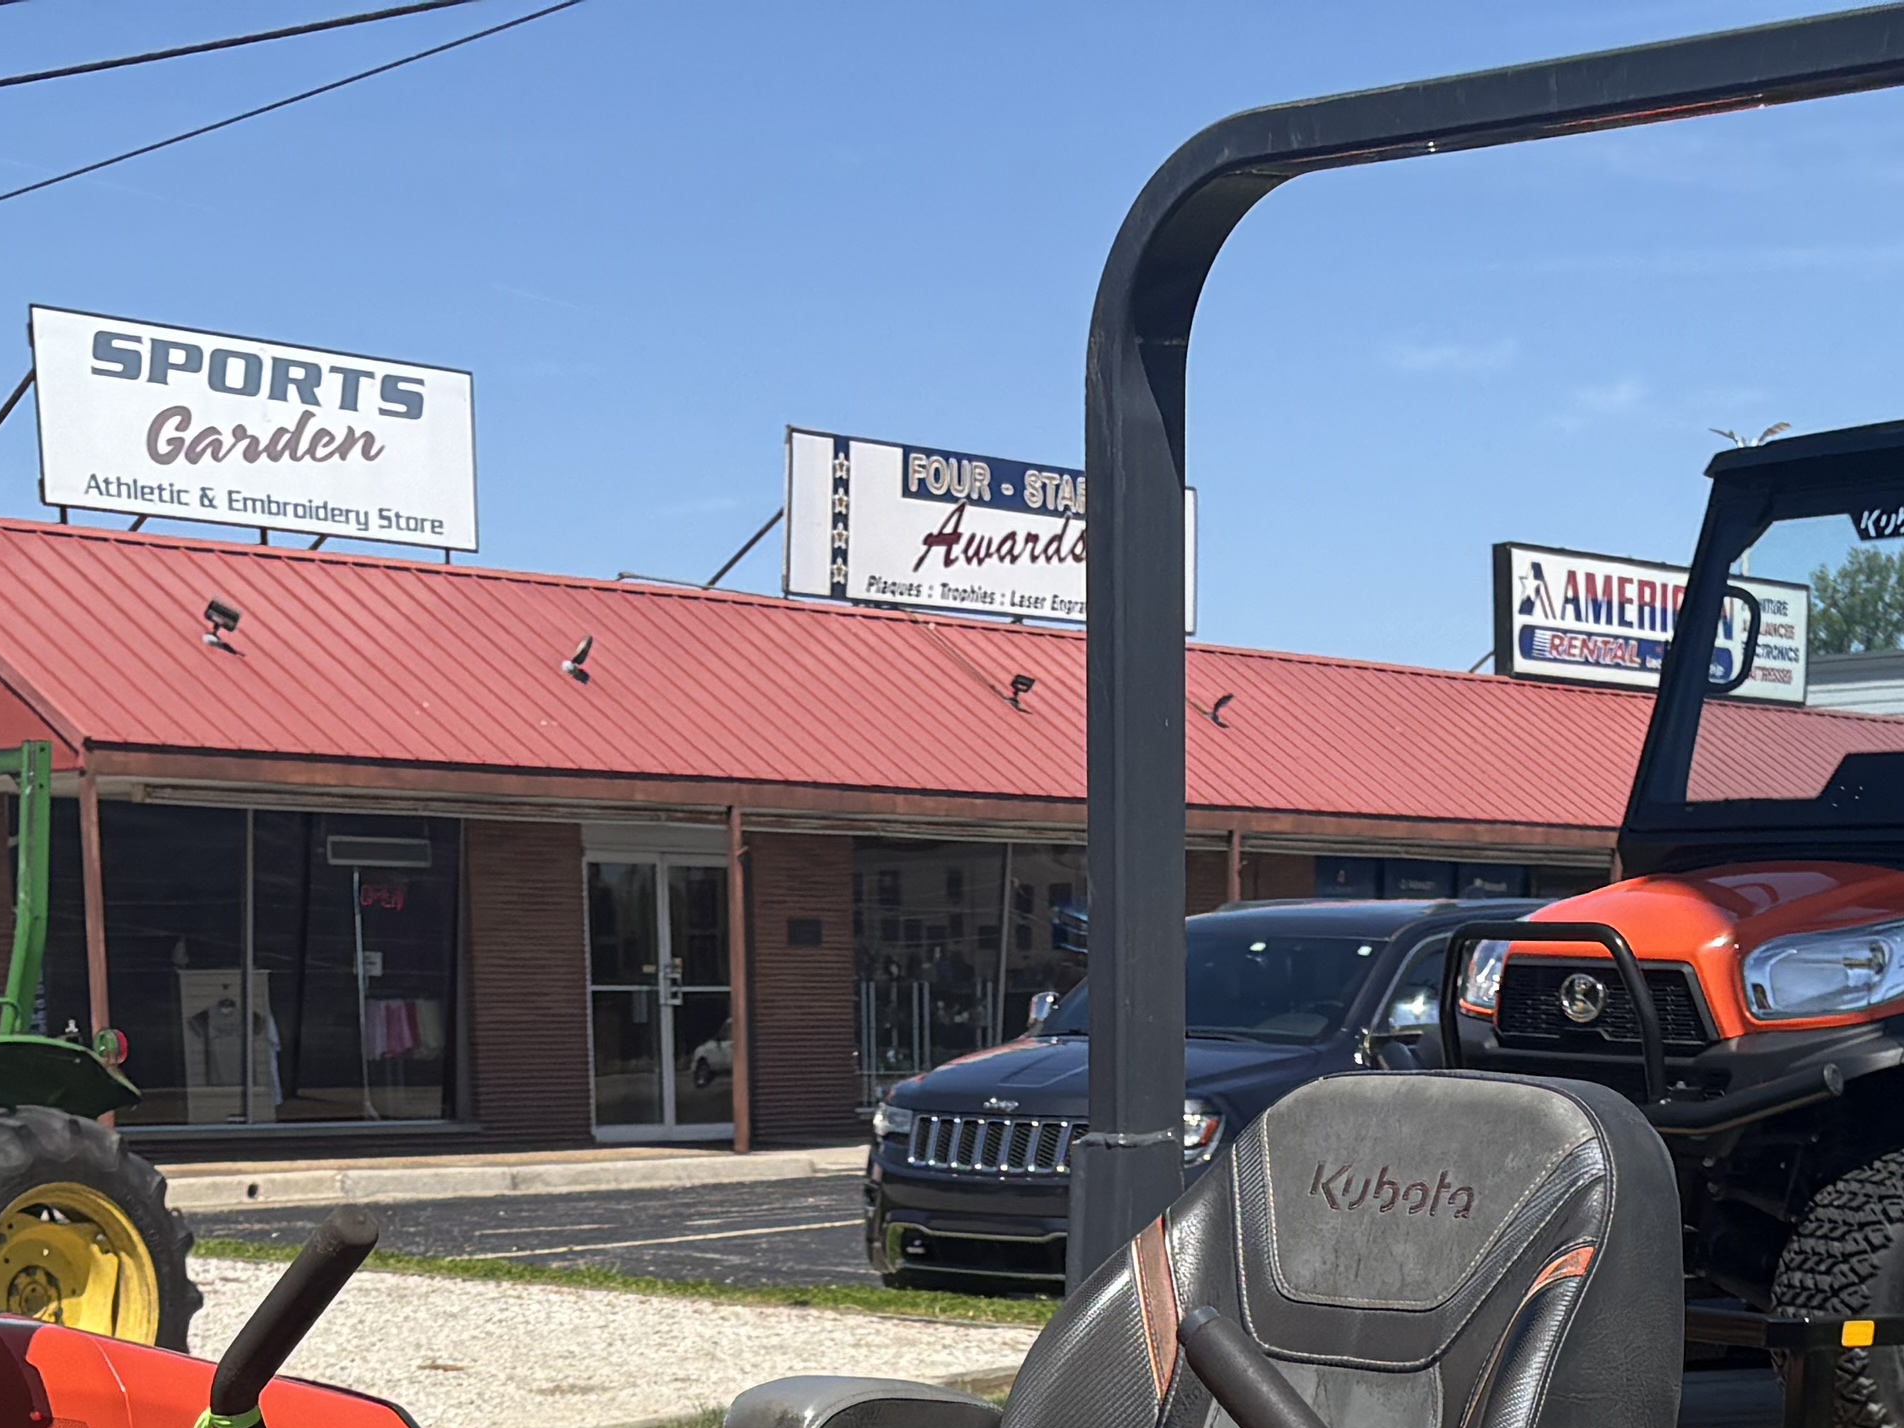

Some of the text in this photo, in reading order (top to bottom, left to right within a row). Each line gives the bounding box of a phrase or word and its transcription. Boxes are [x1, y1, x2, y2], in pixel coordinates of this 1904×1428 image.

[90, 329, 425, 420] SPORTS
[146, 405, 386, 466] Garden
[83, 472, 444, 536] Athletic & Embroidery Store
[908, 453, 992, 501] FOUR
[912, 501, 1086, 573] Awards
[865, 575, 923, 599] Plaques
[940, 582, 996, 606] Trophies
[1010, 589, 1047, 610] Laser
[1549, 632, 1642, 667] RENTAL
[1309, 1160, 1476, 1219] Kubota
